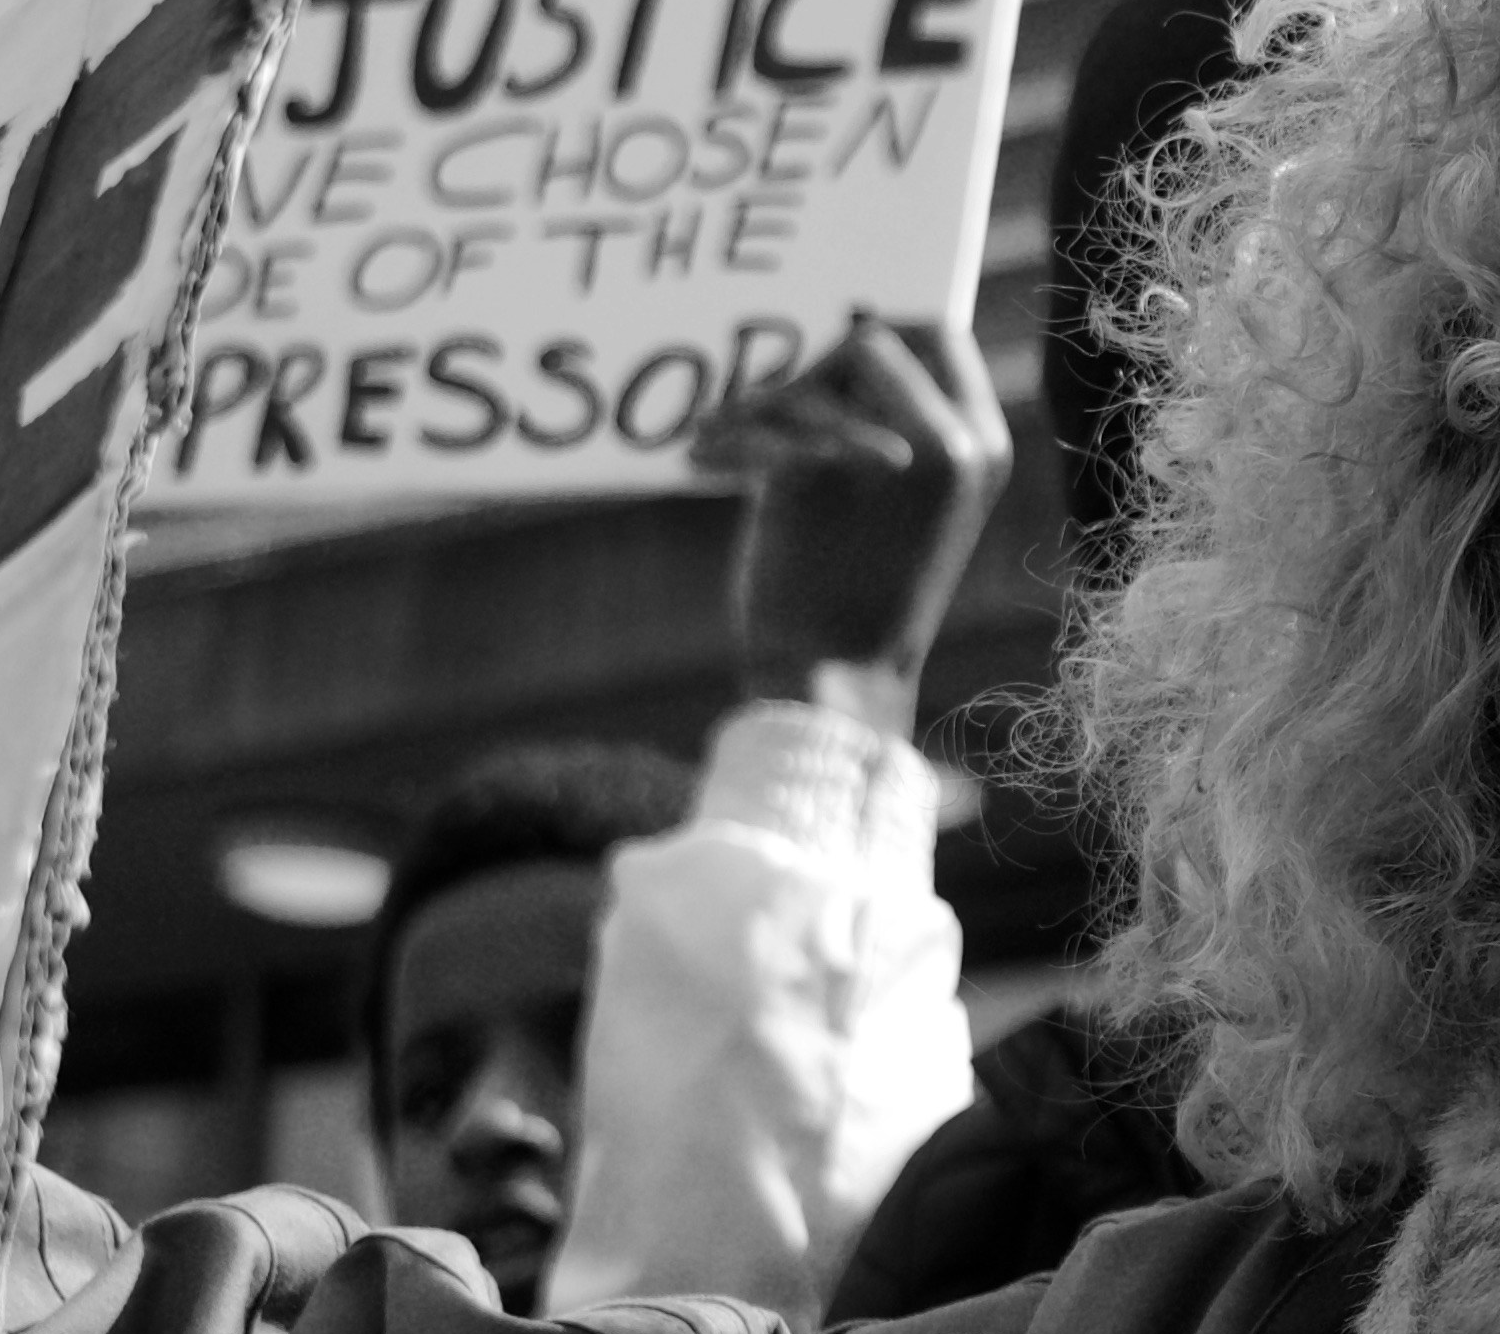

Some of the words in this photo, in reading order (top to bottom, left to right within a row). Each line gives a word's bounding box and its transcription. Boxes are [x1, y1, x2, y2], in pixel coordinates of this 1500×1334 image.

[235, 122, 408, 232] VE
[432, 87, 940, 209] CHOSEN
[198, 237, 318, 319] DE
[350, 221, 514, 312] OF
[542, 190, 806, 296] THE
[172, 315, 804, 479] PRESSOR
